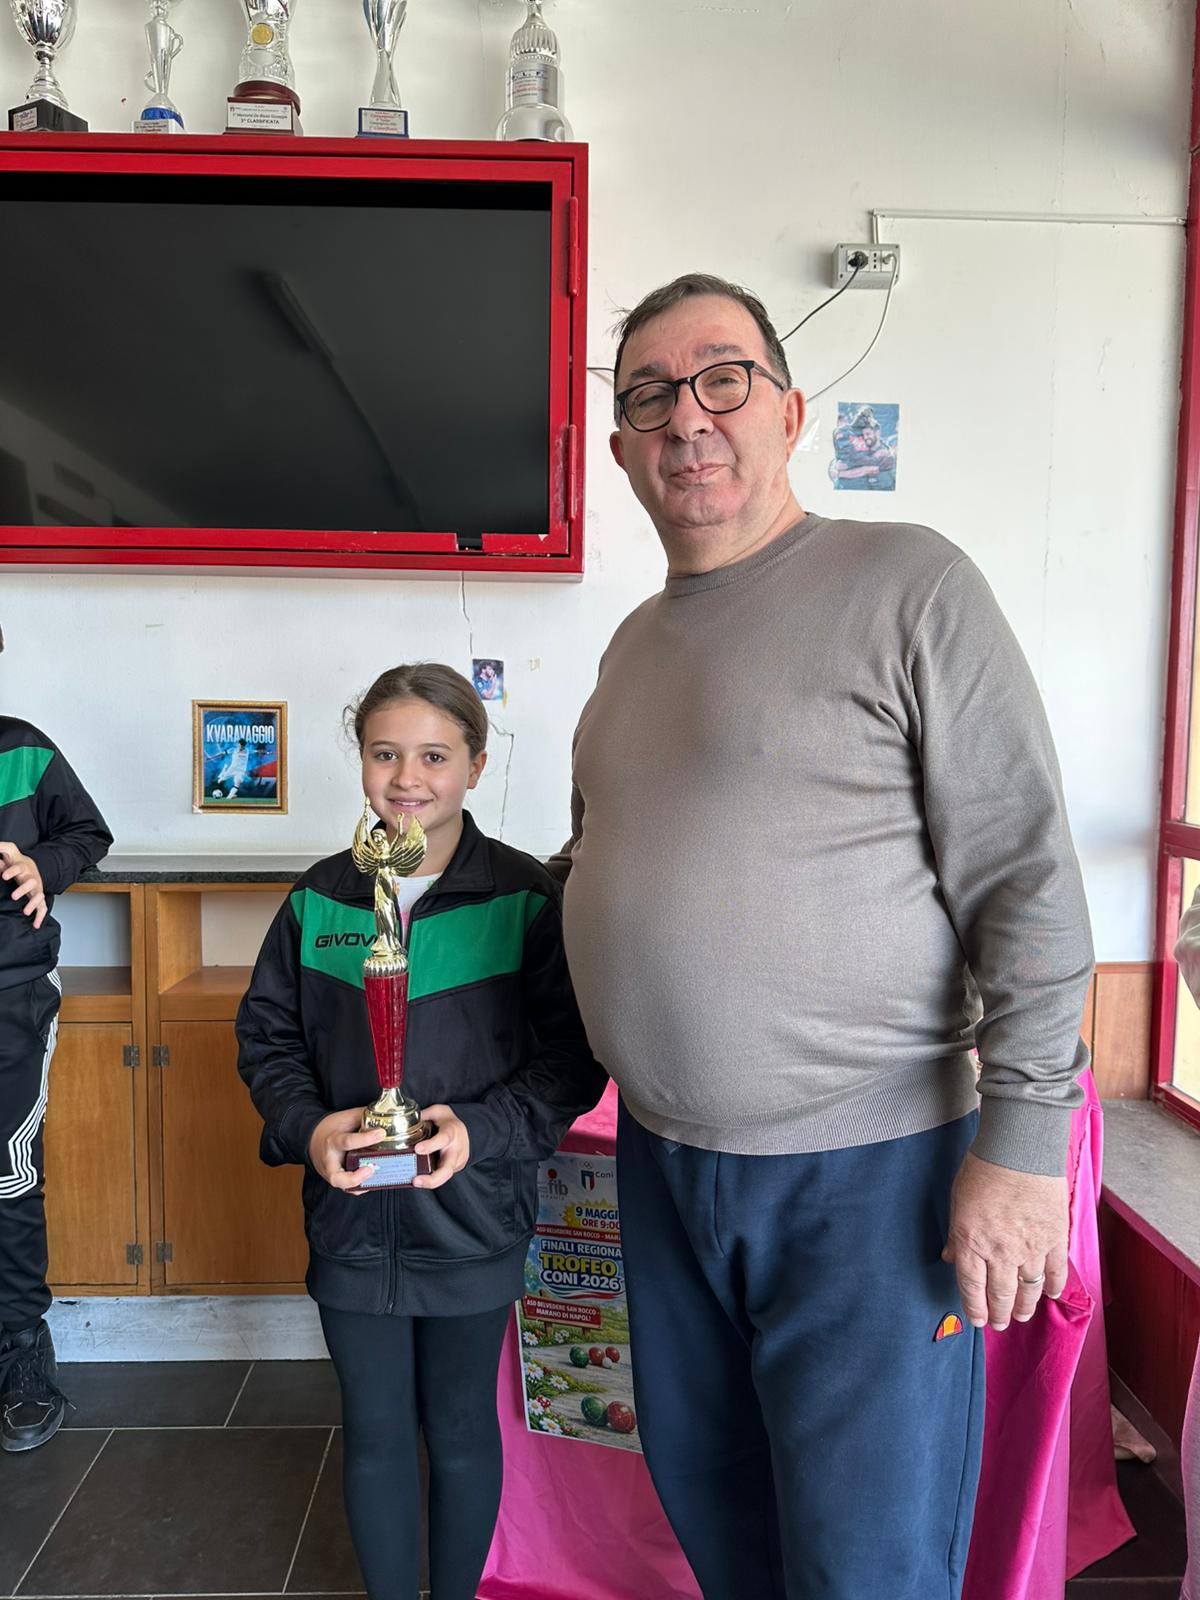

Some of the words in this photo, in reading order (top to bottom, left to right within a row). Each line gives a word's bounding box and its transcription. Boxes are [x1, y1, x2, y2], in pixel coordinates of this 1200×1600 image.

[206, 724, 275, 744] KVARAVAGGIO
[315, 932, 378, 948] GIVOV
[575, 1206, 583, 1217] 9
[585, 1207, 619, 1220] MAGGI
[581, 1218, 599, 1228] ORE
[541, 1240, 575, 1253] FINALI
[577, 1243, 622, 1257] REGIONA
[539, 1253, 617, 1277] TROFEO
[542, 1270, 578, 1285] CONI
[581, 1274, 620, 1290] 2026
[536, 1308, 561, 1318] MARANO
[562, 1311, 569, 1319] DI
[566, 1305, 578, 1313] SAN
[578, 1306, 597, 1315] ROCCO
